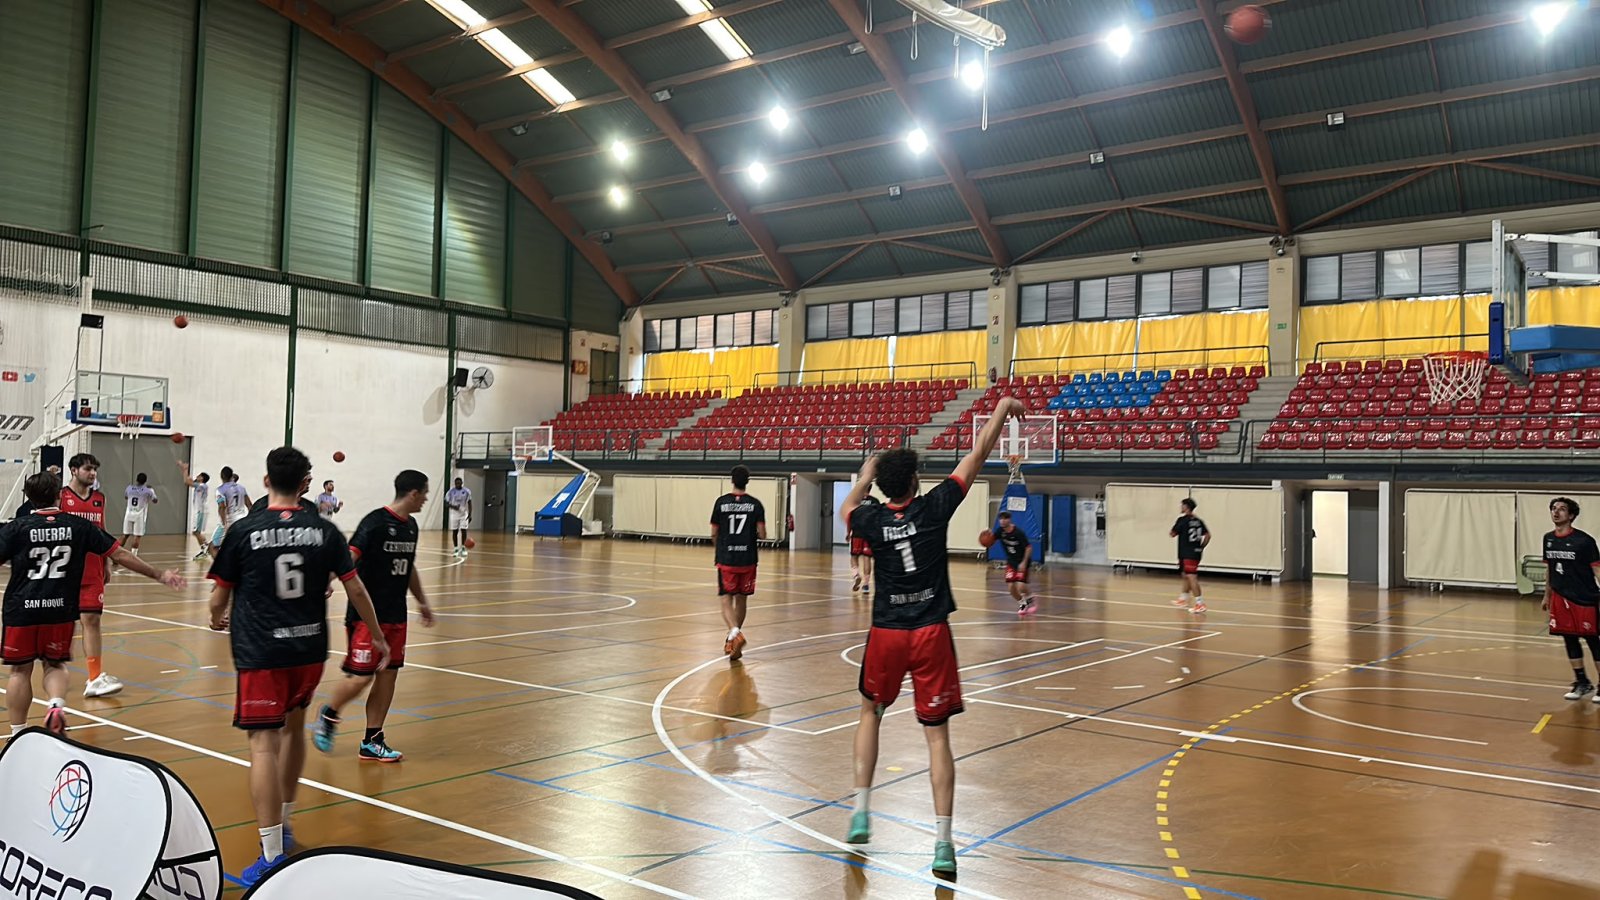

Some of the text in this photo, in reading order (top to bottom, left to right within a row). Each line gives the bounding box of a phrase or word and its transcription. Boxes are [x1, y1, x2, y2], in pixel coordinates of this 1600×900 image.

[728, 514, 747, 534] 17
[29, 527, 72, 542] GUERRA
[27, 545, 71, 580] 32
[894, 540, 917, 572] 1
[275, 553, 304, 600] 6
[391, 558, 408, 576] 30
[24, 598, 64, 609] SAN ROQUE
